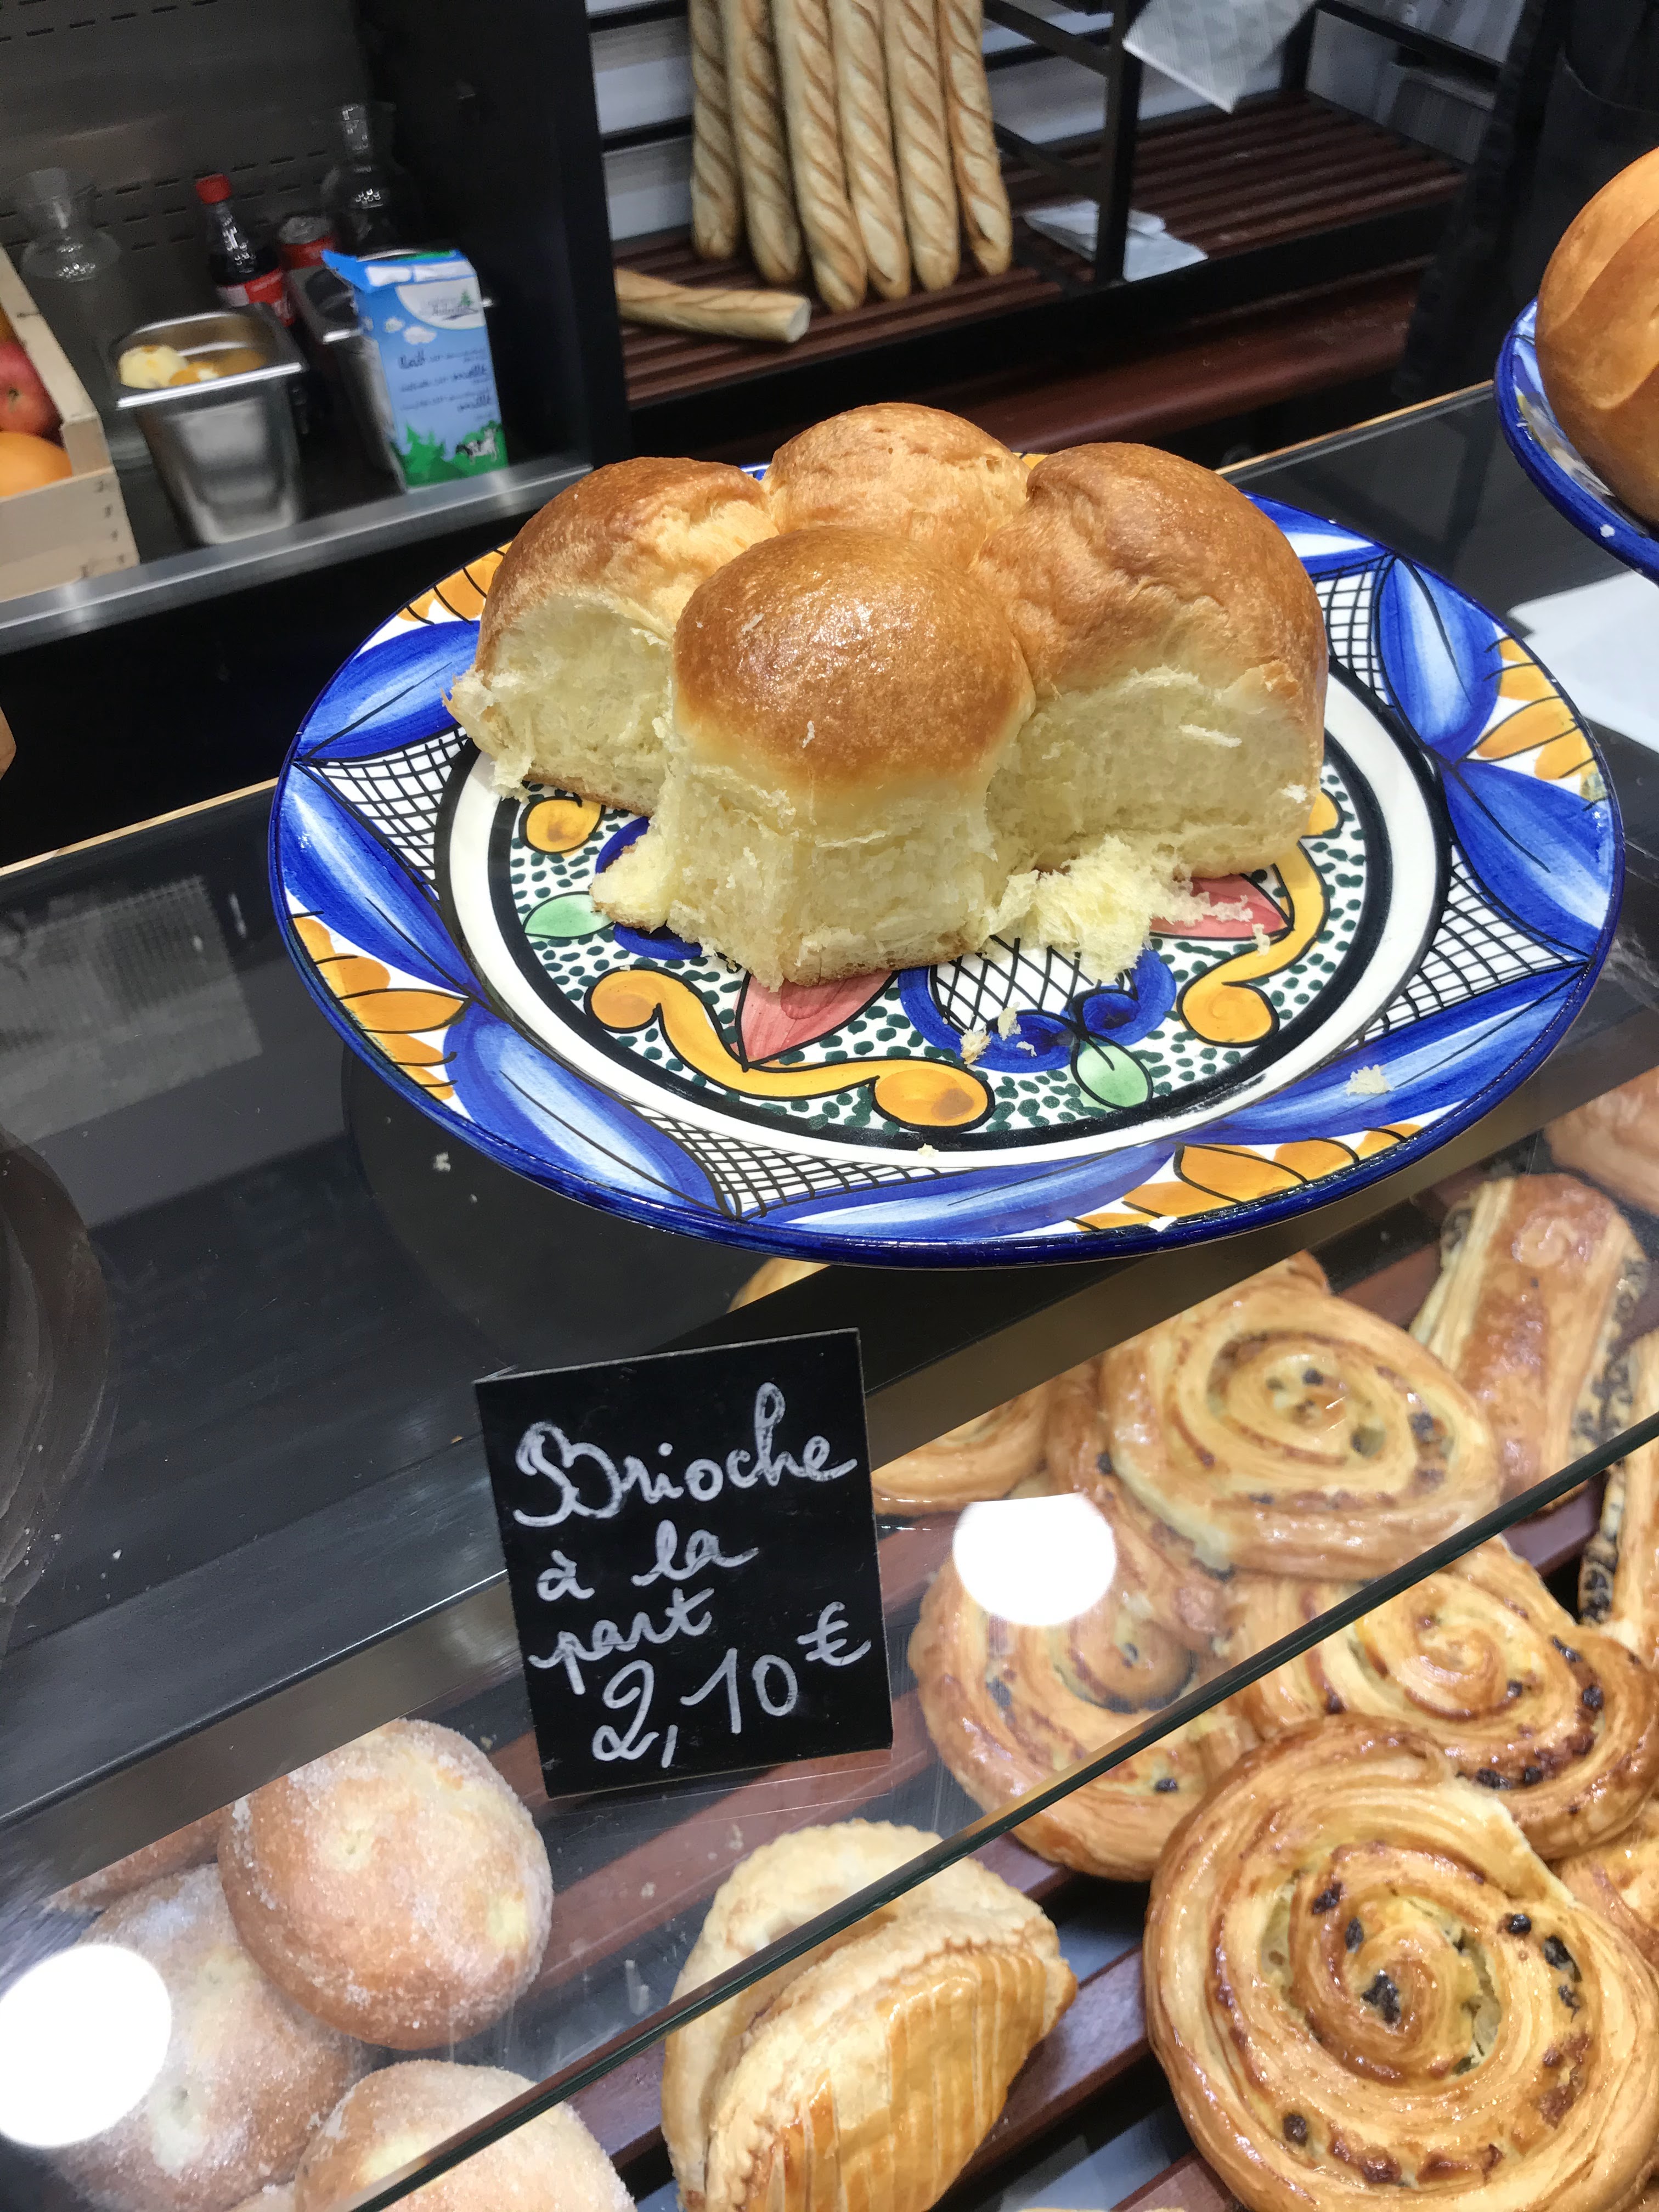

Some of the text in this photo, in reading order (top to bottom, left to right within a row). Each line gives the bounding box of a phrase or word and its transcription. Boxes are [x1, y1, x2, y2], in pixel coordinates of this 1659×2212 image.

[513, 1381, 858, 1527] Brioche
[537, 1519, 760, 1602] à la
[528, 1587, 715, 1696] part
